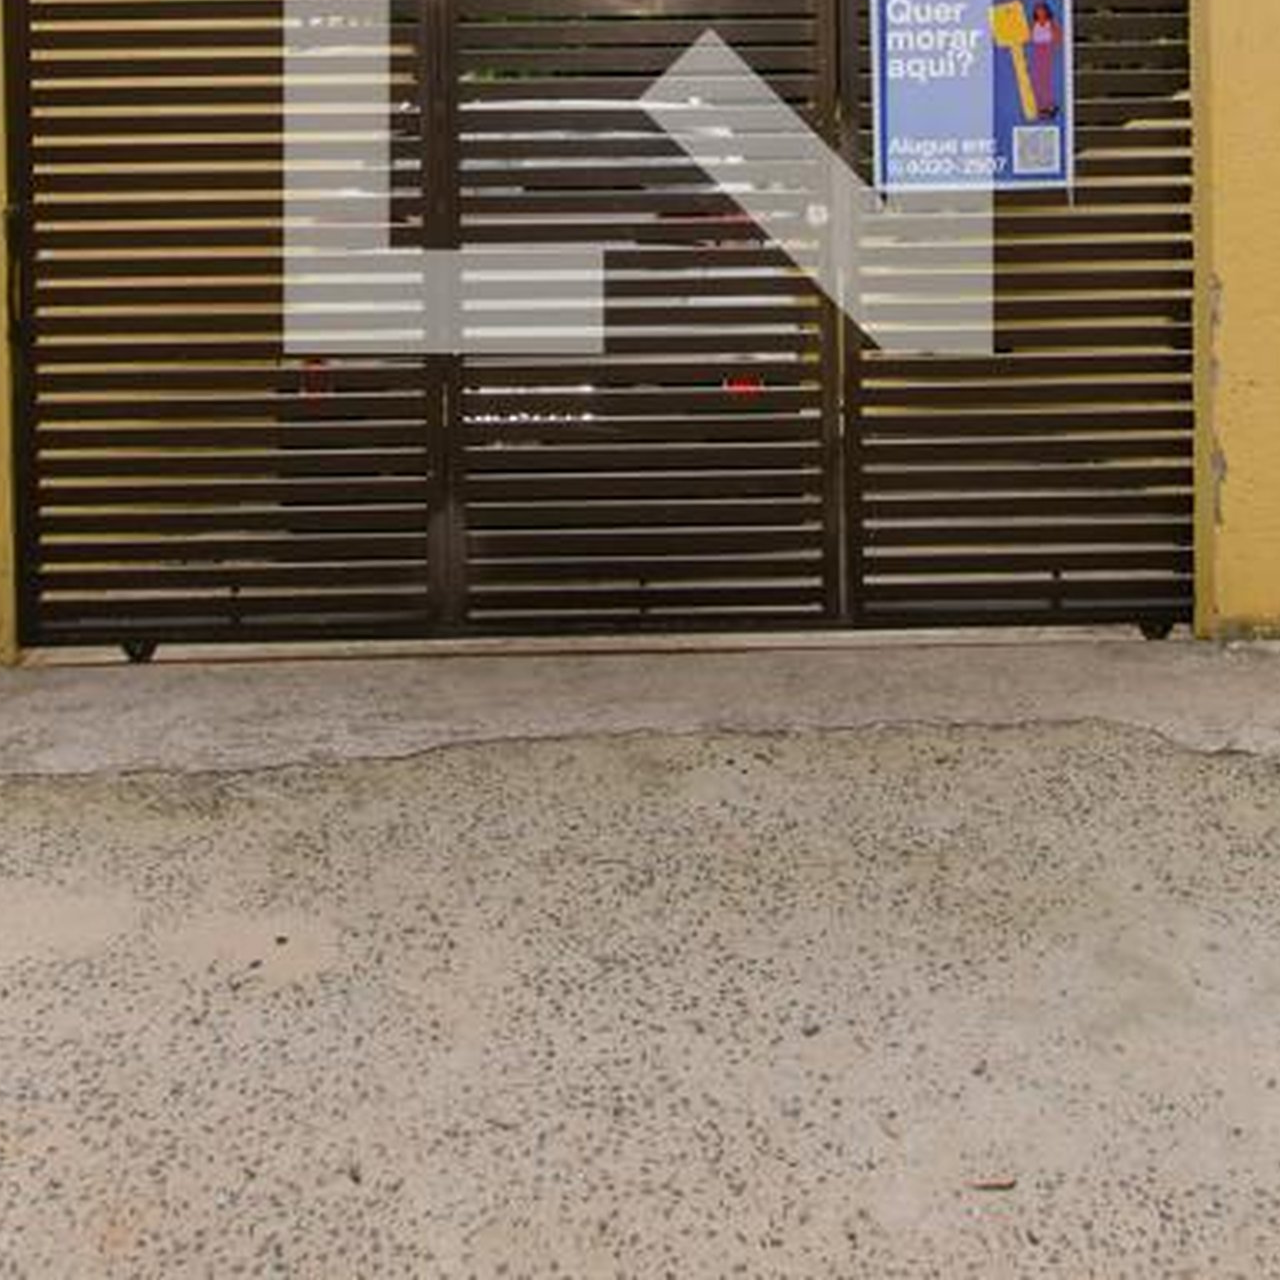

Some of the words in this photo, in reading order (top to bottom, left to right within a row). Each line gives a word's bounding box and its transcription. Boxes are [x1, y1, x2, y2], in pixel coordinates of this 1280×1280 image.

[888, 28, 981, 51] morar
[888, 49, 973, 83] aqui?
[888, 138, 958, 157] Alugue
